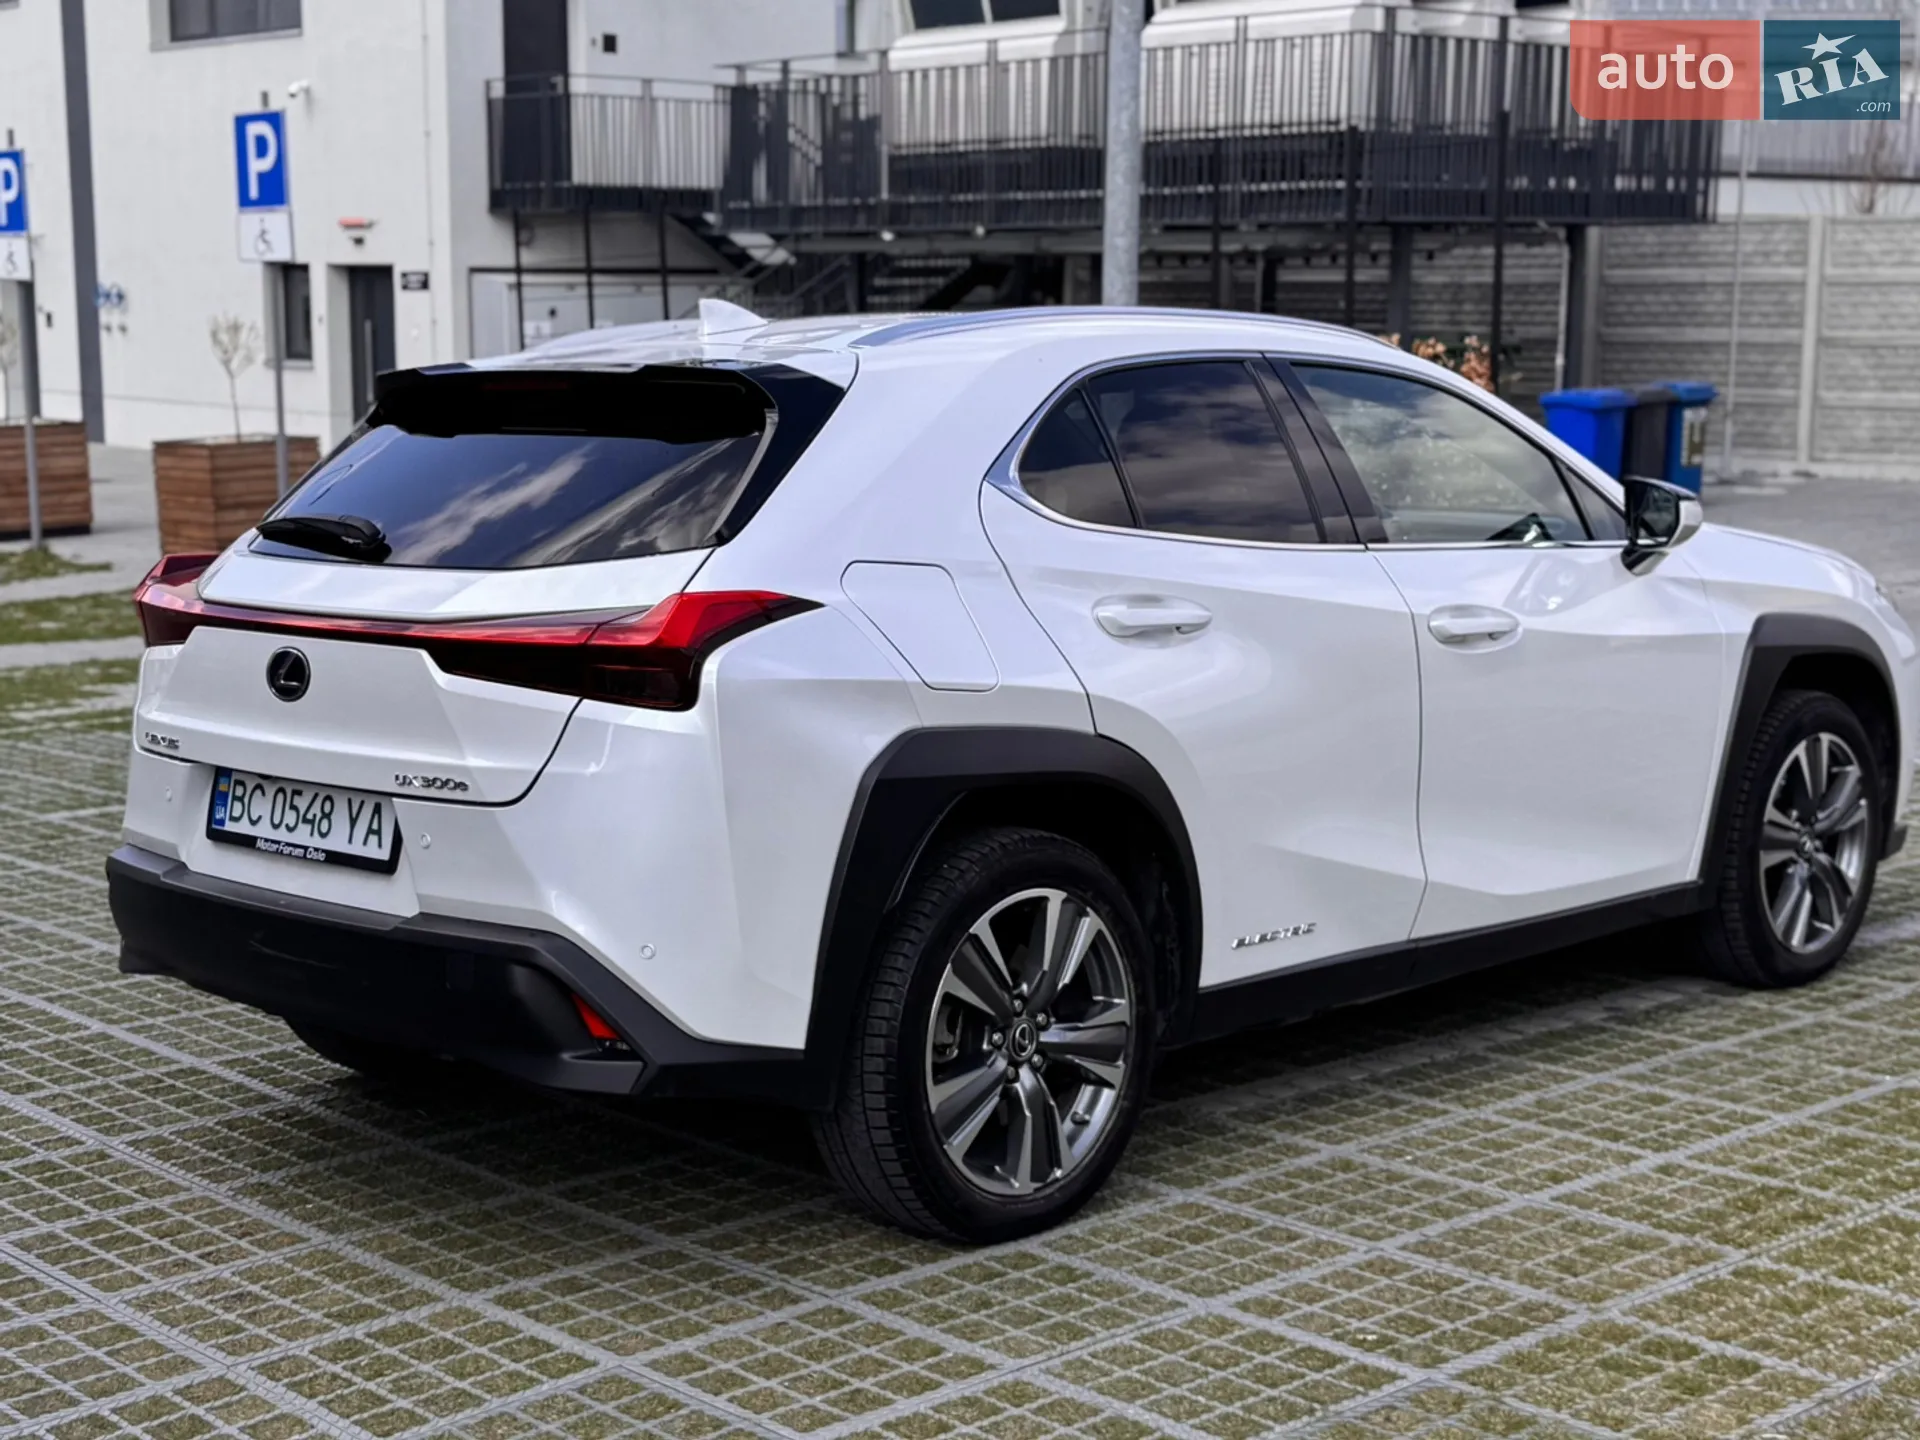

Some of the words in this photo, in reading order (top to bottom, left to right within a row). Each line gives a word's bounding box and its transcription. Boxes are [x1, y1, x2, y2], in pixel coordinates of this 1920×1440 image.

[0, 157, 19, 227] P
[245, 120, 278, 200] P
[228, 779, 266, 827] BC
[269, 786, 335, 839] 0548
[347, 797, 383, 849] YA
[394, 773, 469, 792] UX300e
[306, 846, 326, 861] Oslo
